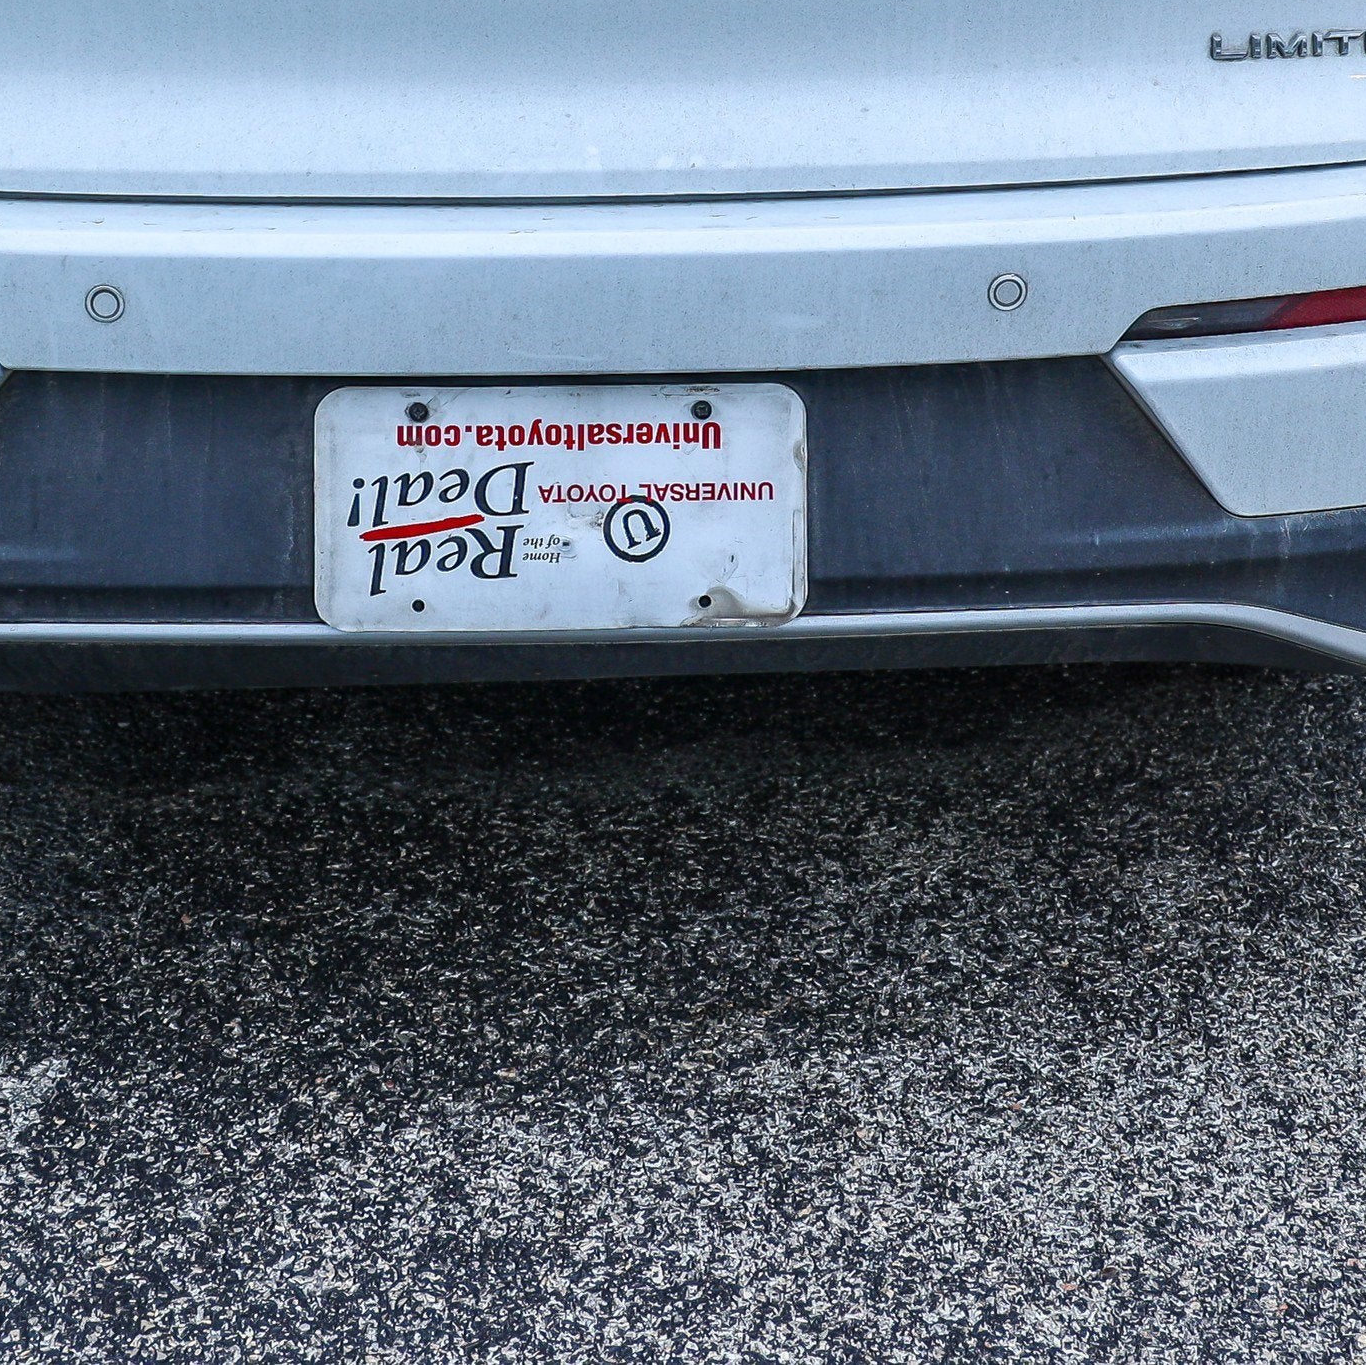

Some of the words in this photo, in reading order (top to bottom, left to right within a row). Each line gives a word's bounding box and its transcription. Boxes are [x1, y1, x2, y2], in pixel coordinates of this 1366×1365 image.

[395, 418, 723, 452] Universaltoyota.com
[346, 460, 535, 528] Deal!
[537, 482, 632, 504] TOYOTA
[640, 481, 775, 503] UNIVERSAL
[522, 537, 544, 550] the
[546, 534, 561, 550] of
[365, 523, 524, 597] Real
[522, 551, 562, 565] Home
